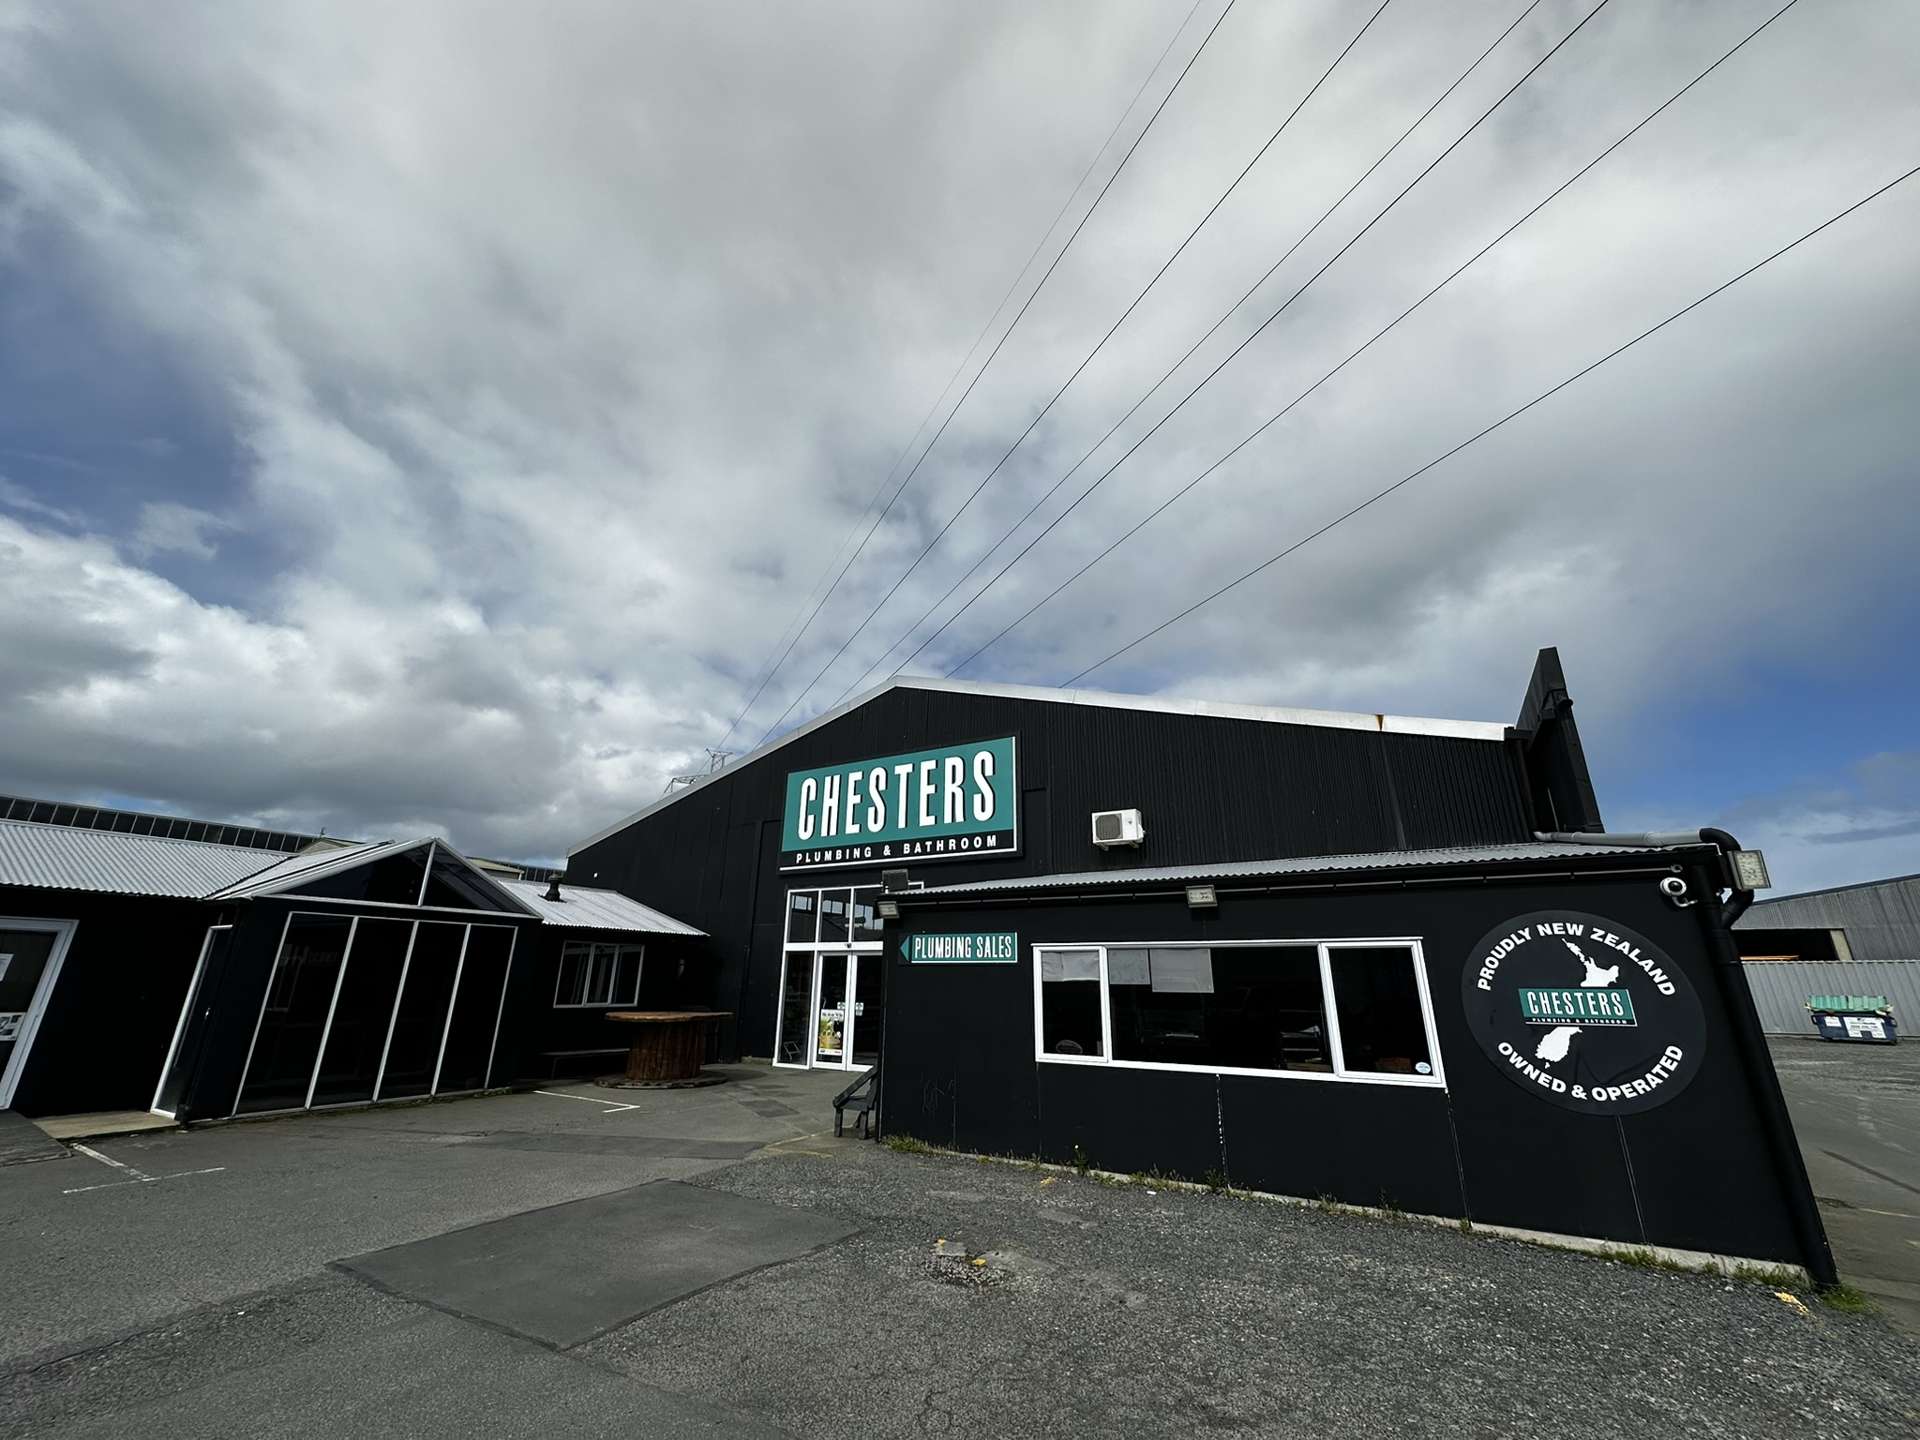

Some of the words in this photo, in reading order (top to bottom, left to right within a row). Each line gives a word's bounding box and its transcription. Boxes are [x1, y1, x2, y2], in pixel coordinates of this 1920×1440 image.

[798, 750, 996, 841] CHESTERS
[796, 846, 872, 864] PLUMBING
[883, 845, 891, 856] &
[903, 834, 998, 855] BATHROOM
[914, 936, 972, 959] PLUMBING
[976, 935, 1012, 959] SALES
[1477, 927, 1532, 991] PROUDLY
[1536, 922, 1584, 937] NEW
[1590, 927, 1676, 996] ZEALAND
[1527, 991, 1624, 1017] CHESTERS
[1497, 1041, 1567, 1093] OWNED
[1571, 1084, 1588, 1100] &
[1591, 1044, 1684, 1102] OPERATED
